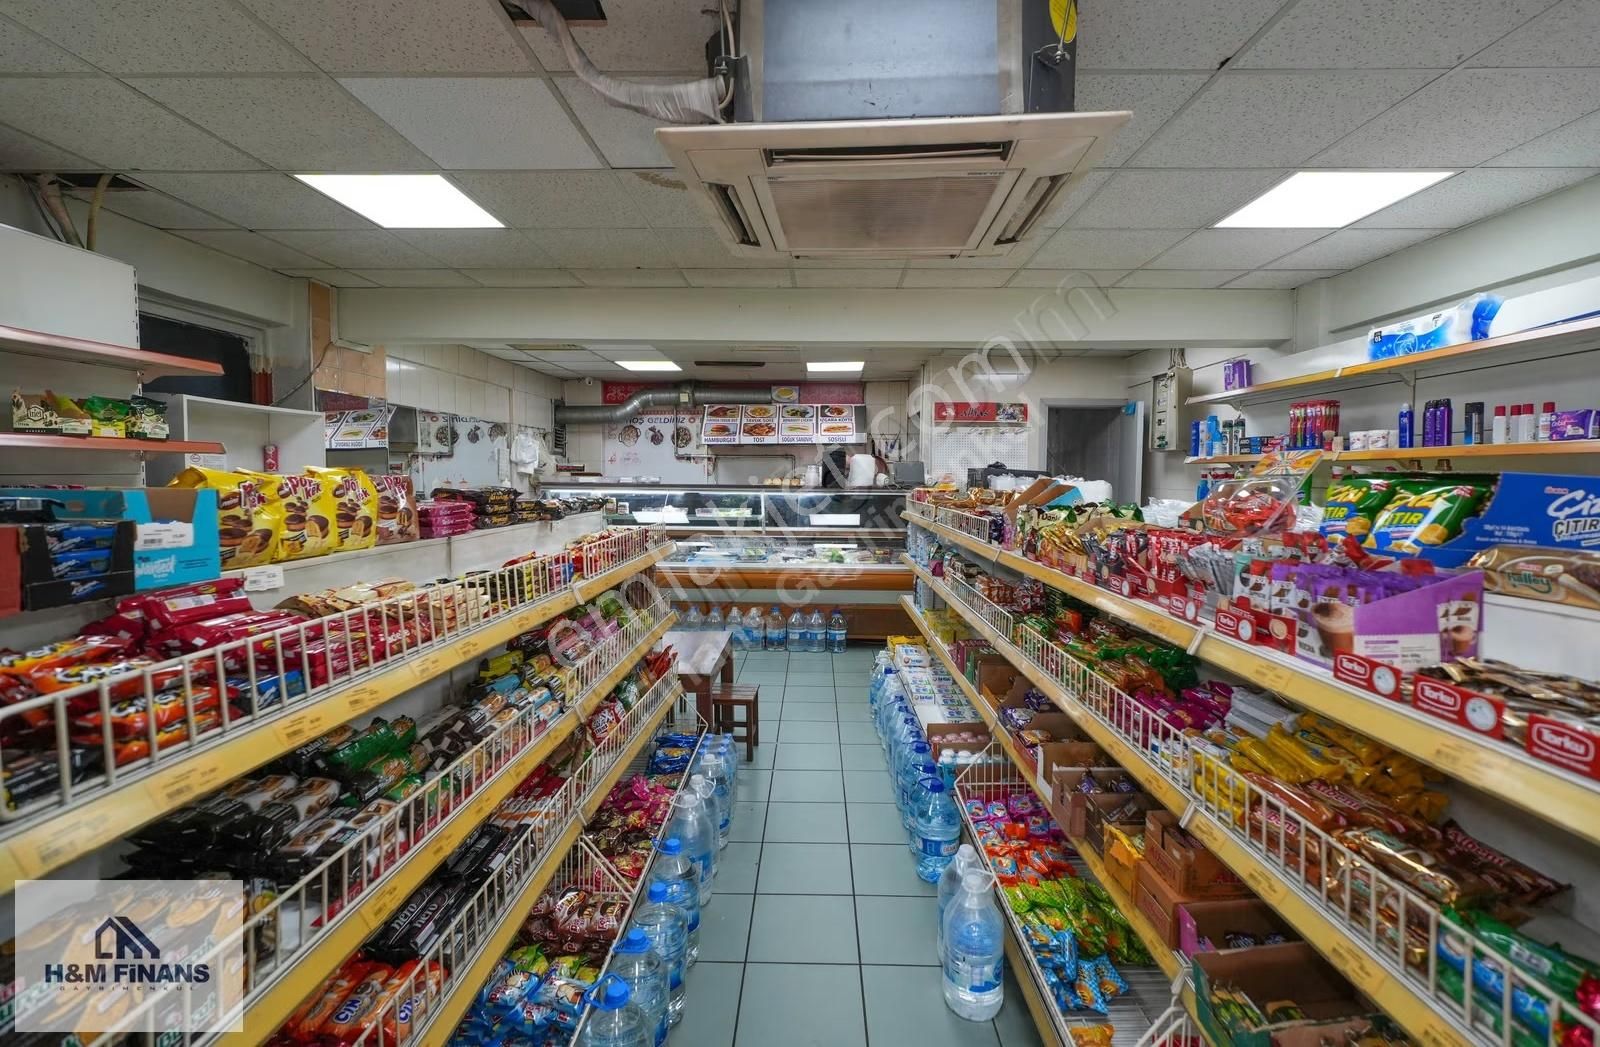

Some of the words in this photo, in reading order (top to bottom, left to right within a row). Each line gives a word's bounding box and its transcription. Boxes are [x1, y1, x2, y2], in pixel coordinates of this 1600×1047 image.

[1341, 657, 1366, 675] Torku
[1423, 684, 1455, 706] Torku
[1540, 727, 1586, 755] Torku
[391, 902, 418, 931] nero
[412, 902, 439, 929] nero
